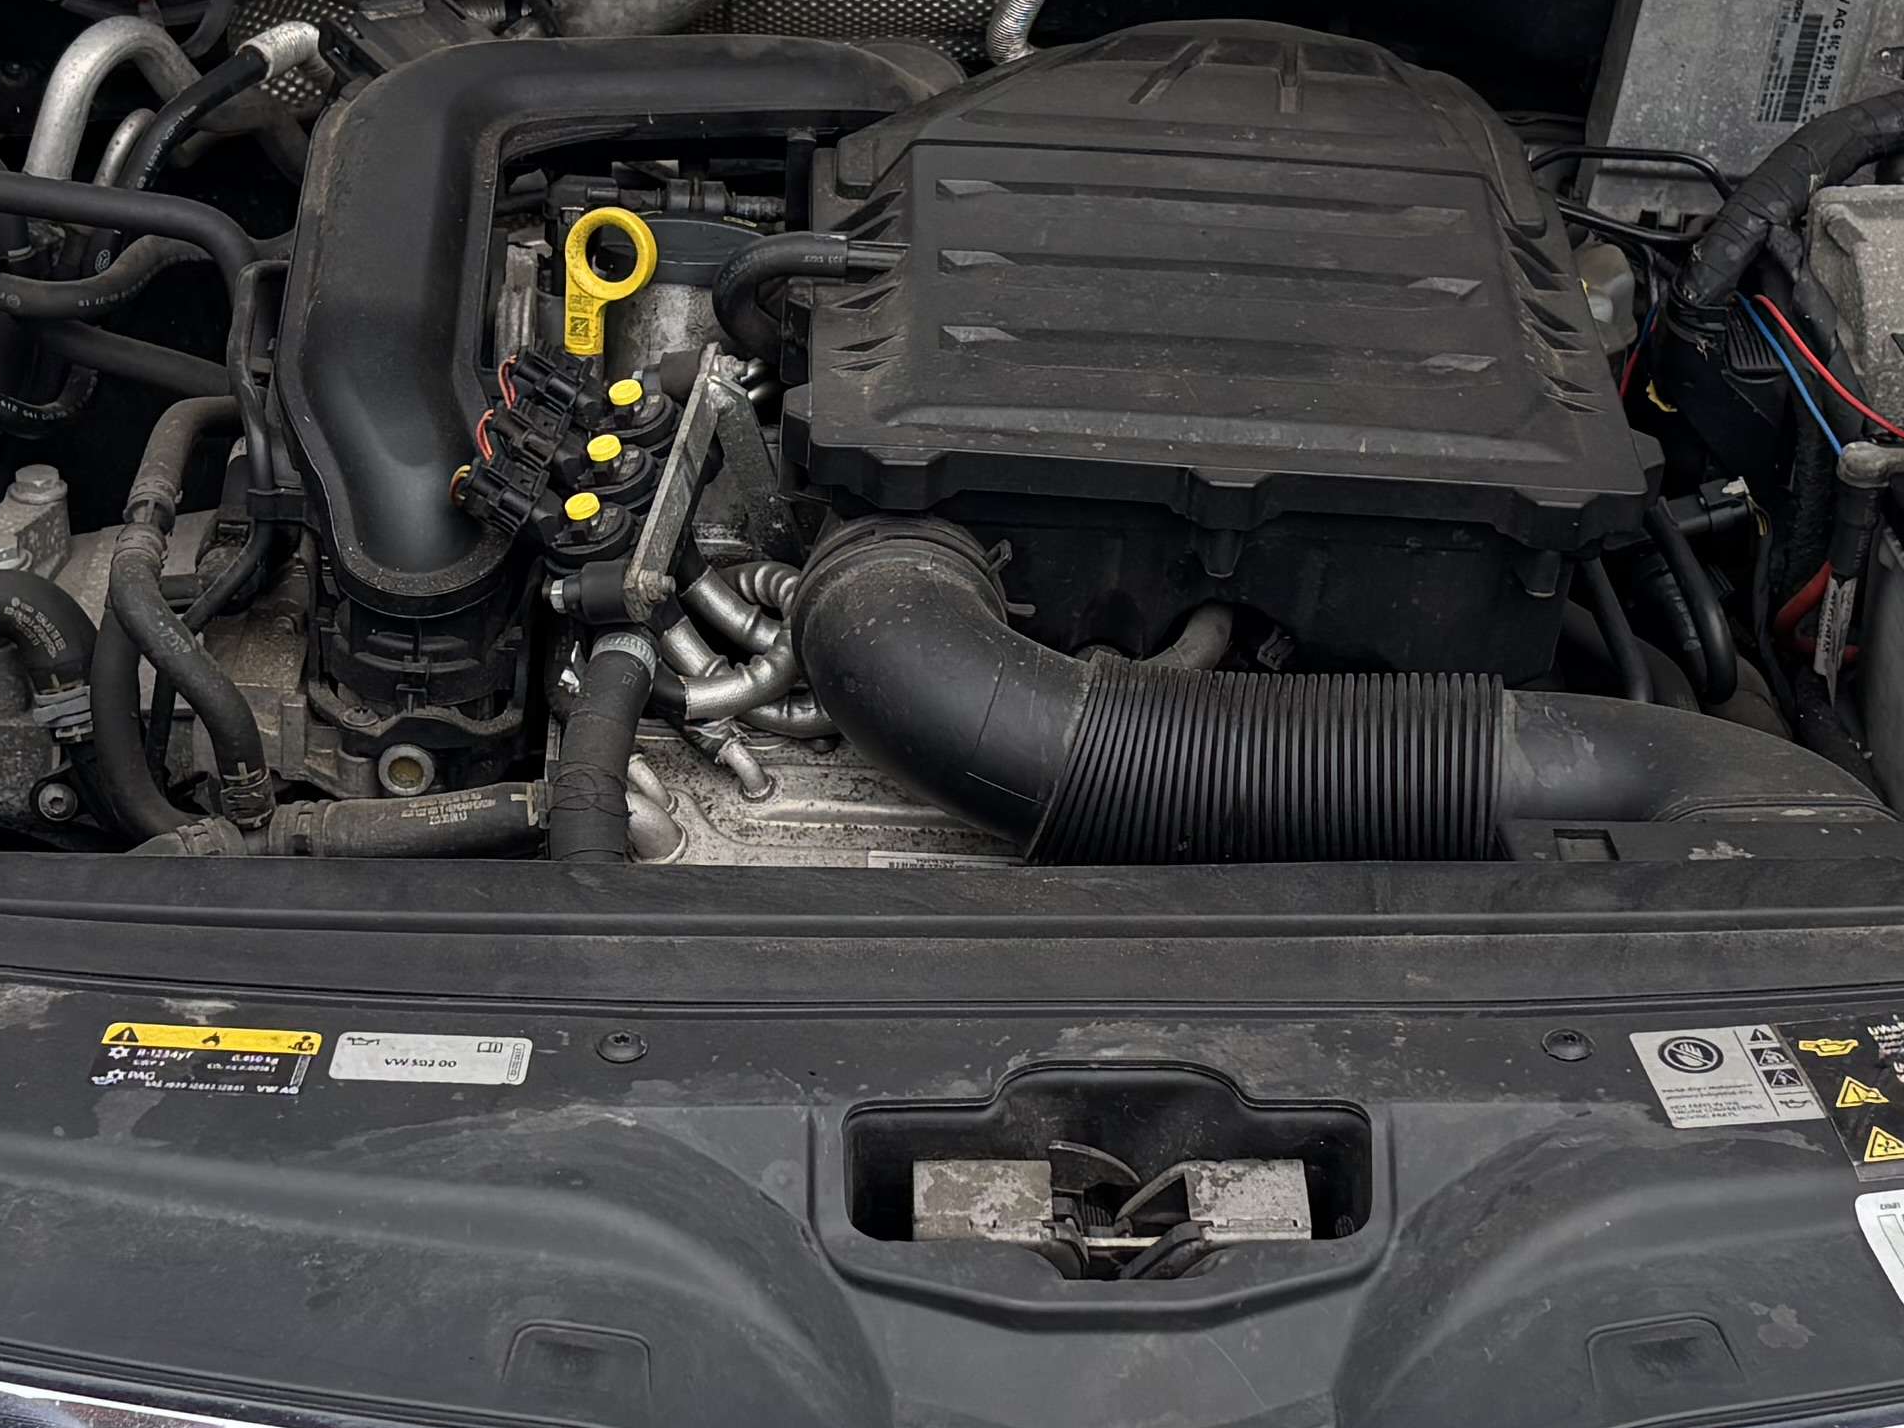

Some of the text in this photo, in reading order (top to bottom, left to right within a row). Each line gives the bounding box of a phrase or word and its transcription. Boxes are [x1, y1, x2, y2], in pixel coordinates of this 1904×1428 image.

[1832, 8, 1847, 29] AG
[384, 1058, 409, 1066] VW
[438, 1060, 457, 1068] 00
